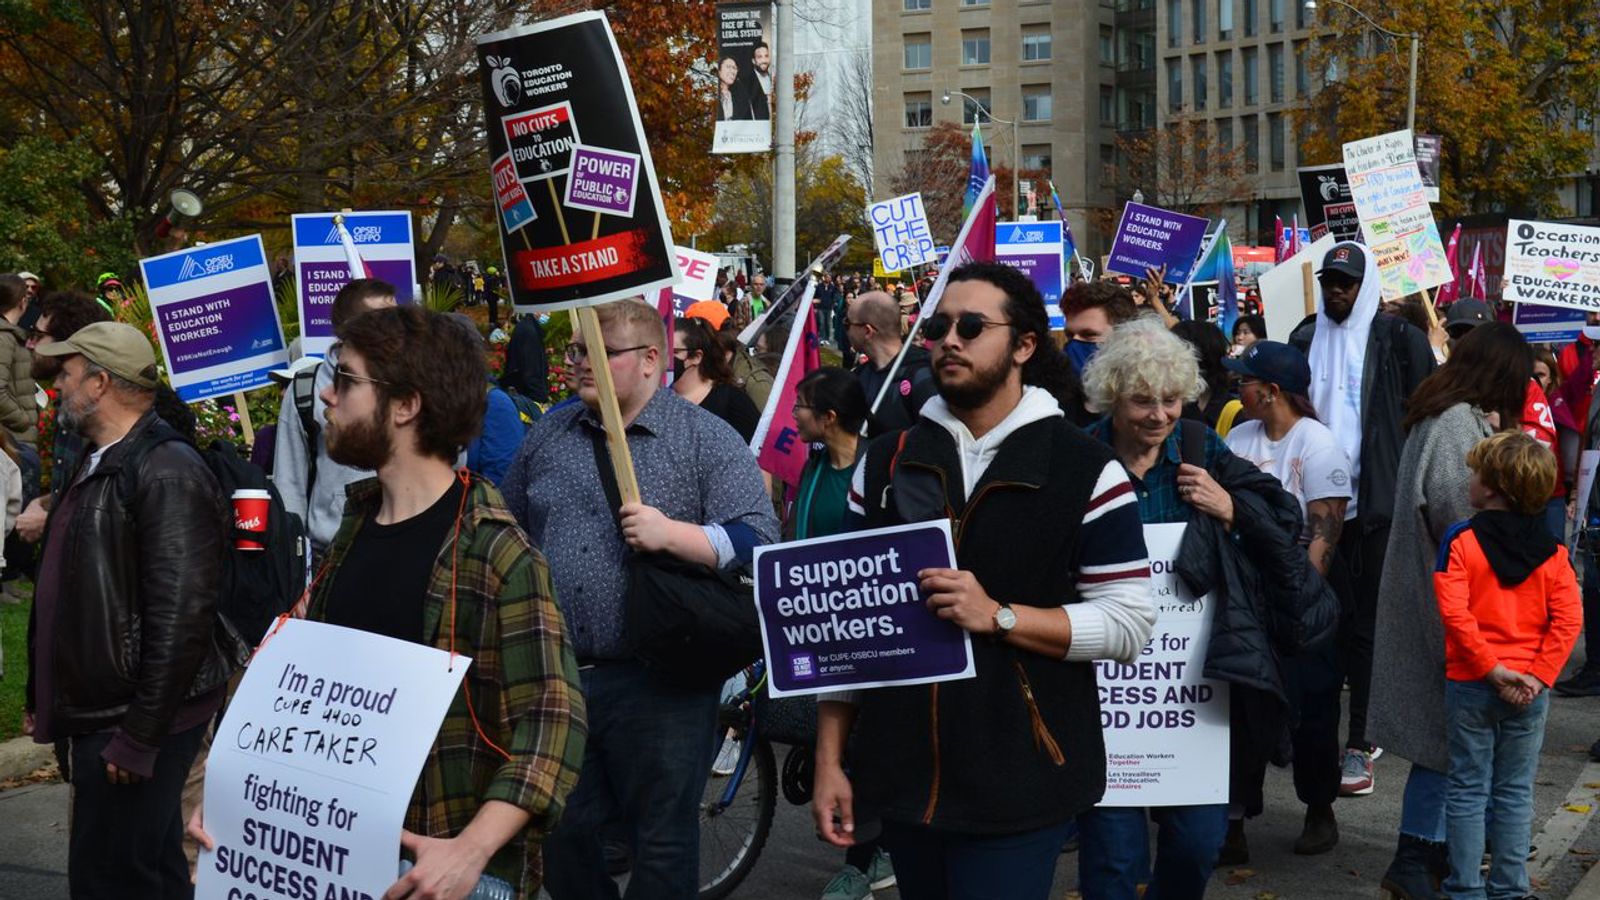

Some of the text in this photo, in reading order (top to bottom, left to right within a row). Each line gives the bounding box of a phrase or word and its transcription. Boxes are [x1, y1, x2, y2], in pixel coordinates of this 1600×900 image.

[721, 20, 757, 29] FACE OF THE
[721, 29, 763, 39] LEGAL SYSTEM
[521, 63, 563, 78] TORONTO
[524, 71, 573, 88] EDUCATION
[525, 82, 569, 97] WORKERS
[512, 113, 560, 137] NO CUTS
[533, 134, 542, 142] TO
[513, 136, 574, 163] EDUCATION
[576, 171, 584, 179] OF
[577, 156, 632, 180] POWER
[574, 178, 613, 195] PUBLIC
[572, 190, 613, 204] EDUCATION
[871, 195, 919, 226] CUT
[352, 226, 382, 235] OPSEU
[1130, 211, 1182, 231] I STAND WITH
[353, 233, 382, 243] SEFPO
[876, 218, 928, 246] THE
[1126, 223, 1171, 240] EDUCATION
[1517, 223, 1600, 244] Occasion
[1123, 234, 1164, 251] WORKERS.
[1514, 241, 1600, 263] Teachers
[205, 253, 233, 267] OPSEU
[206, 261, 234, 274] SEFPO
[529, 246, 619, 279] TAKE A STAND
[676, 254, 711, 280] PE
[307, 271, 311, 280] I
[313, 270, 345, 280] STAND
[1512, 274, 1600, 294] EDUCATION
[308, 282, 348, 293] EDUCAT
[1516, 286, 1600, 307] WORKERS
[164, 299, 231, 321] I STAND WITH
[168, 313, 223, 332] EDUCATION
[170, 326, 223, 343] WORKERS.
[1533, 402, 1556, 431] 2
[774, 547, 902, 588] I support
[777, 578, 919, 617] education
[1159, 600, 1204, 614] tired)
[783, 613, 904, 646] workers.
[1161, 633, 1190, 651] for
[879, 648, 916, 658] members
[829, 664, 856, 673] anyone.
[1093, 661, 1187, 681] TUDENT
[278, 663, 397, 715] I'm a proud
[1098, 685, 1213, 706] CESS AND
[273, 695, 362, 727] CUPE 4400
[1101, 709, 1196, 730] OD JOBS
[243, 773, 358, 832] fighting for
[242, 818, 350, 876] STUDENT
[215, 845, 318, 900] SUCCESS
